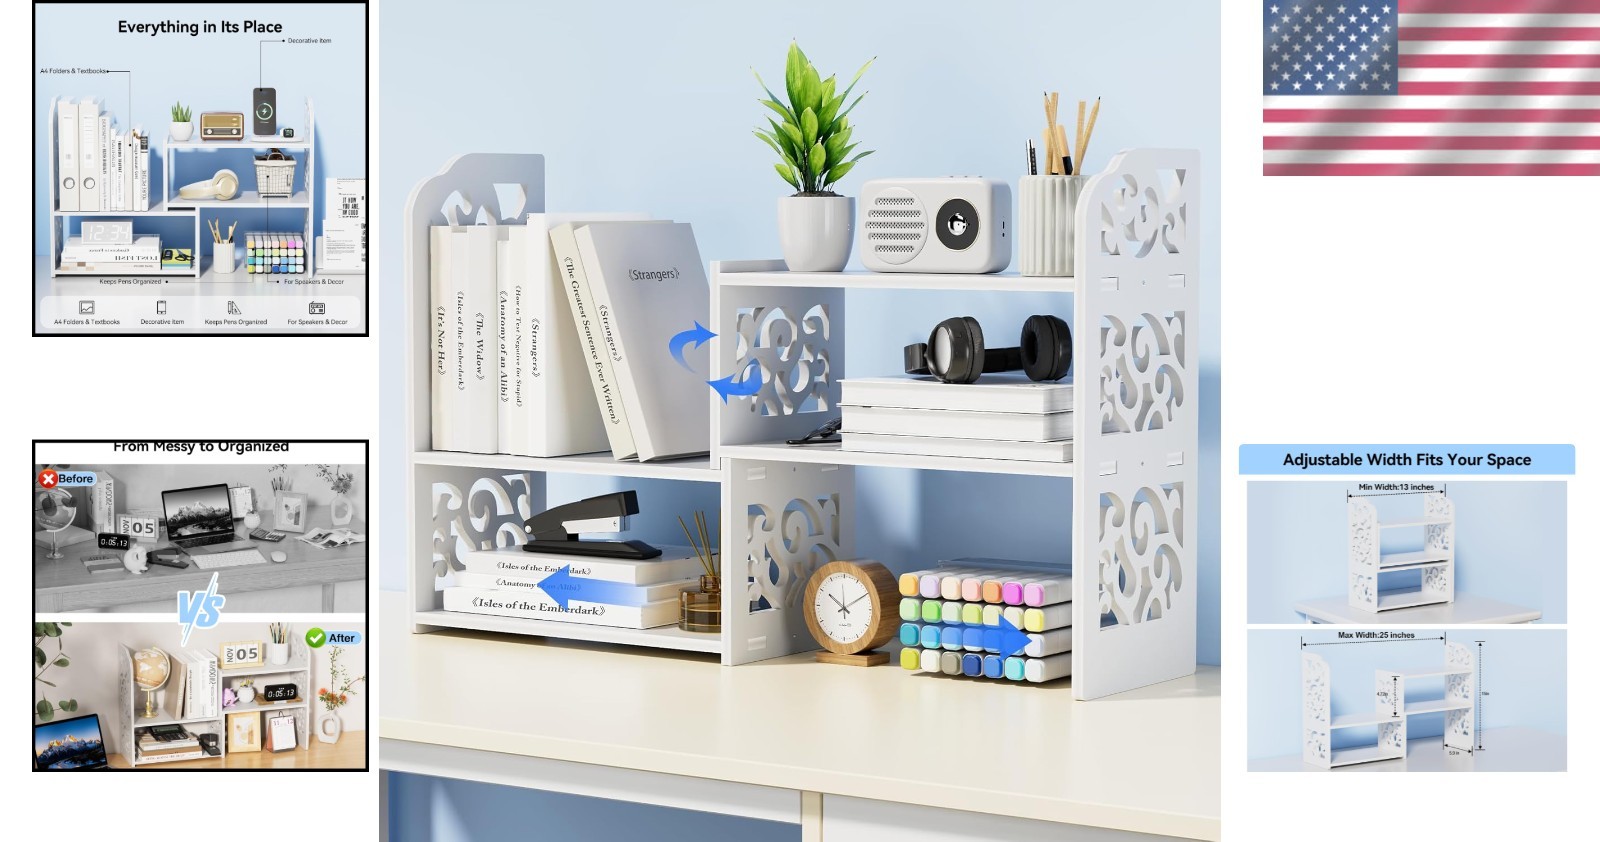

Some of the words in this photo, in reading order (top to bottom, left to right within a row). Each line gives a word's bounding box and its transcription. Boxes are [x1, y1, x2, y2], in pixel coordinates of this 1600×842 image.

[515, 307, 521, 315] to
[571, 280, 586, 319] Greatest
[583, 320, 598, 360] Sentence
[594, 361, 606, 383] Ever
[437, 330, 445, 348] Not
[500, 343, 508, 356] of
[500, 356, 506, 368] an
[122, 519, 130, 534] NOV
[530, 564, 543, 572] the
[505, 600, 518, 609] of
[519, 601, 536, 611] the
